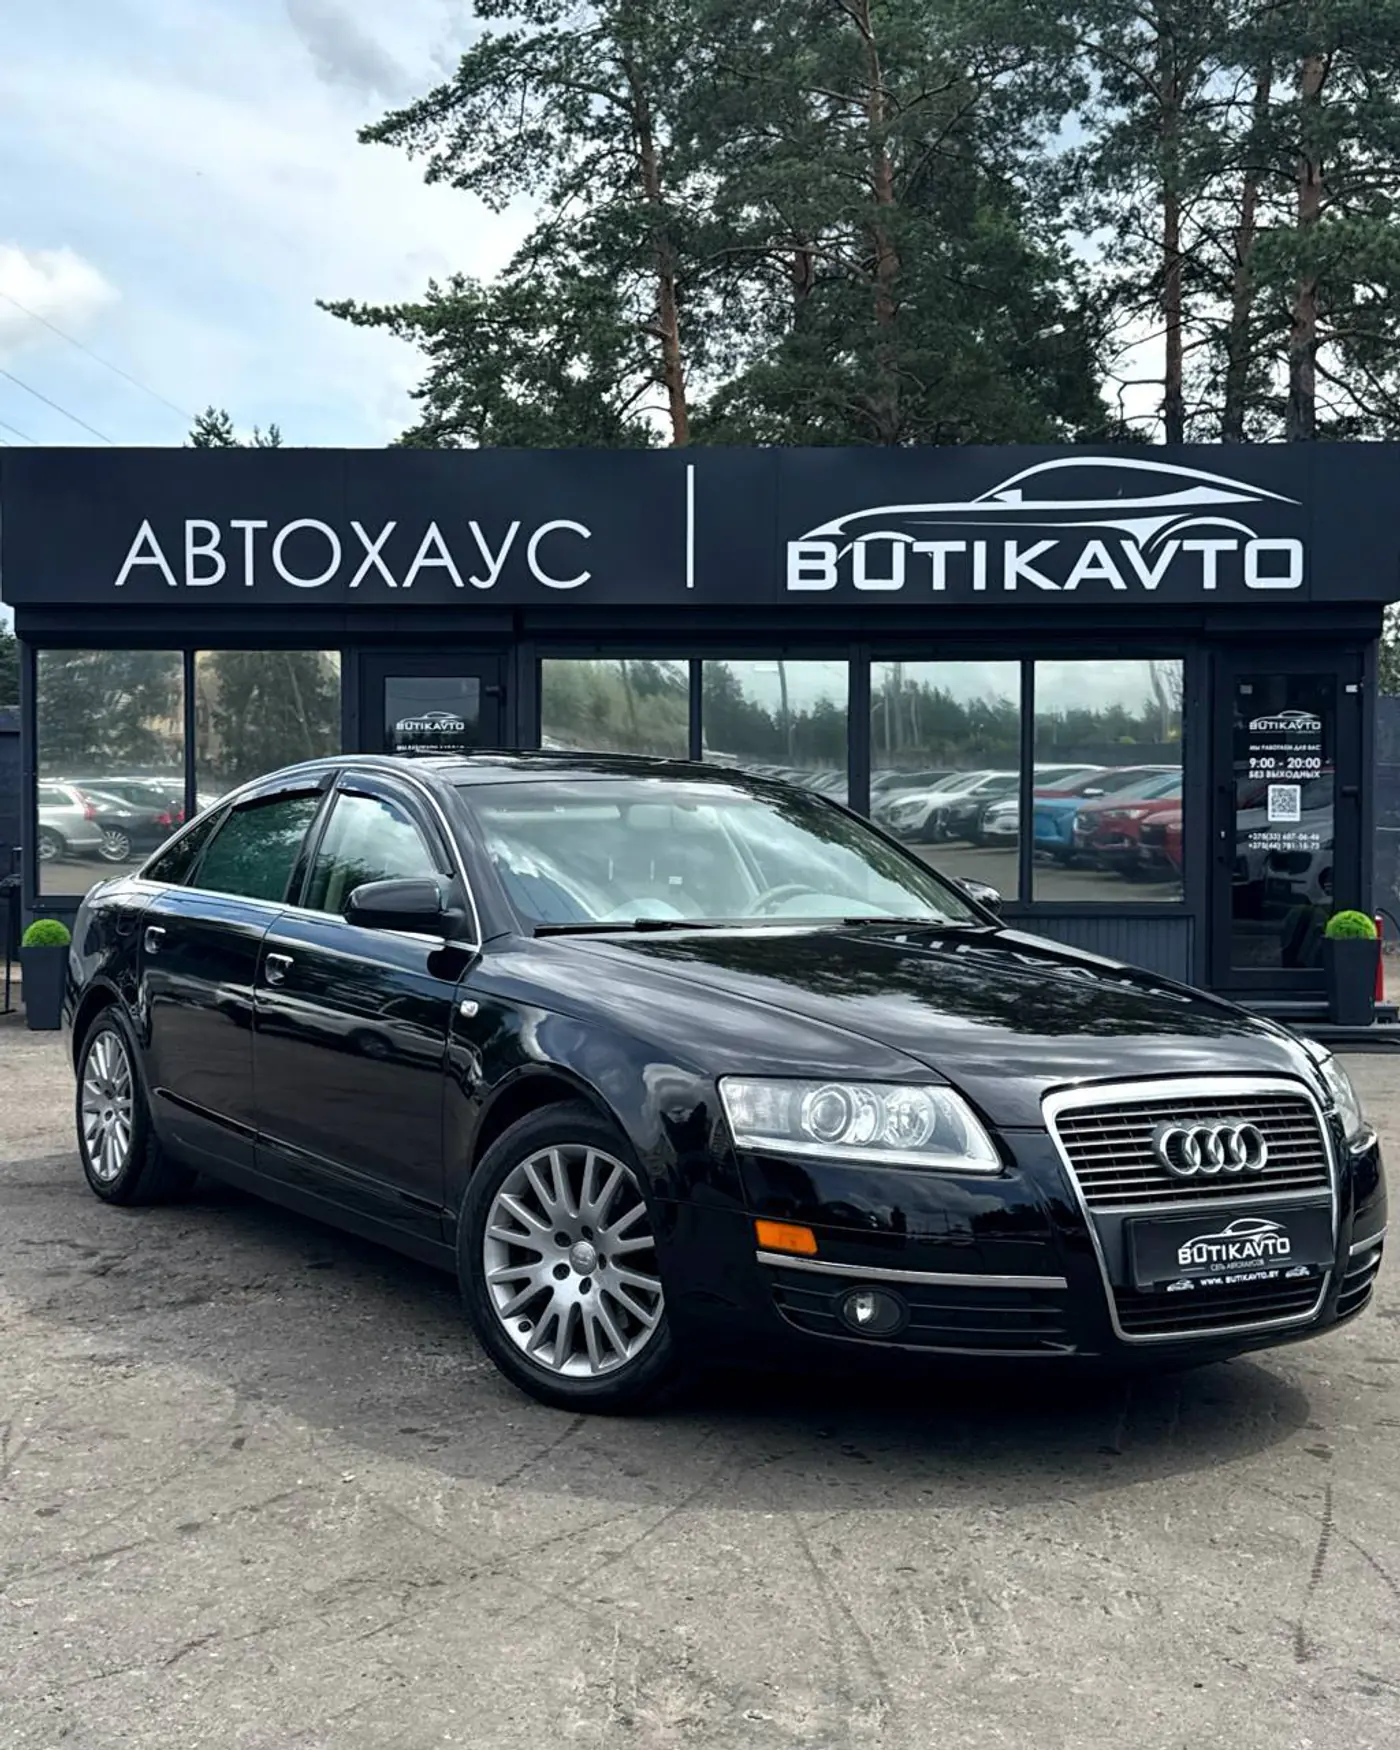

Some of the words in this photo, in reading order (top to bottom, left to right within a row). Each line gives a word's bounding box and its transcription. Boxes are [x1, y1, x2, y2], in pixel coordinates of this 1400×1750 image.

[114, 518, 592, 589] АВТОХАУС
[787, 539, 1303, 591] BUTIKAVTO
[396, 721, 465, 731] BUTIKAVTO
[1249, 721, 1322, 730] BUTIKAVTO
[1249, 757, 1275, 769] 9:00
[1286, 757, 1321, 769] 20:00
[1265, 770, 1321, 779] ВЫХОДНЫХ
[1178, 1237, 1291, 1264] BUTIKAVTO
